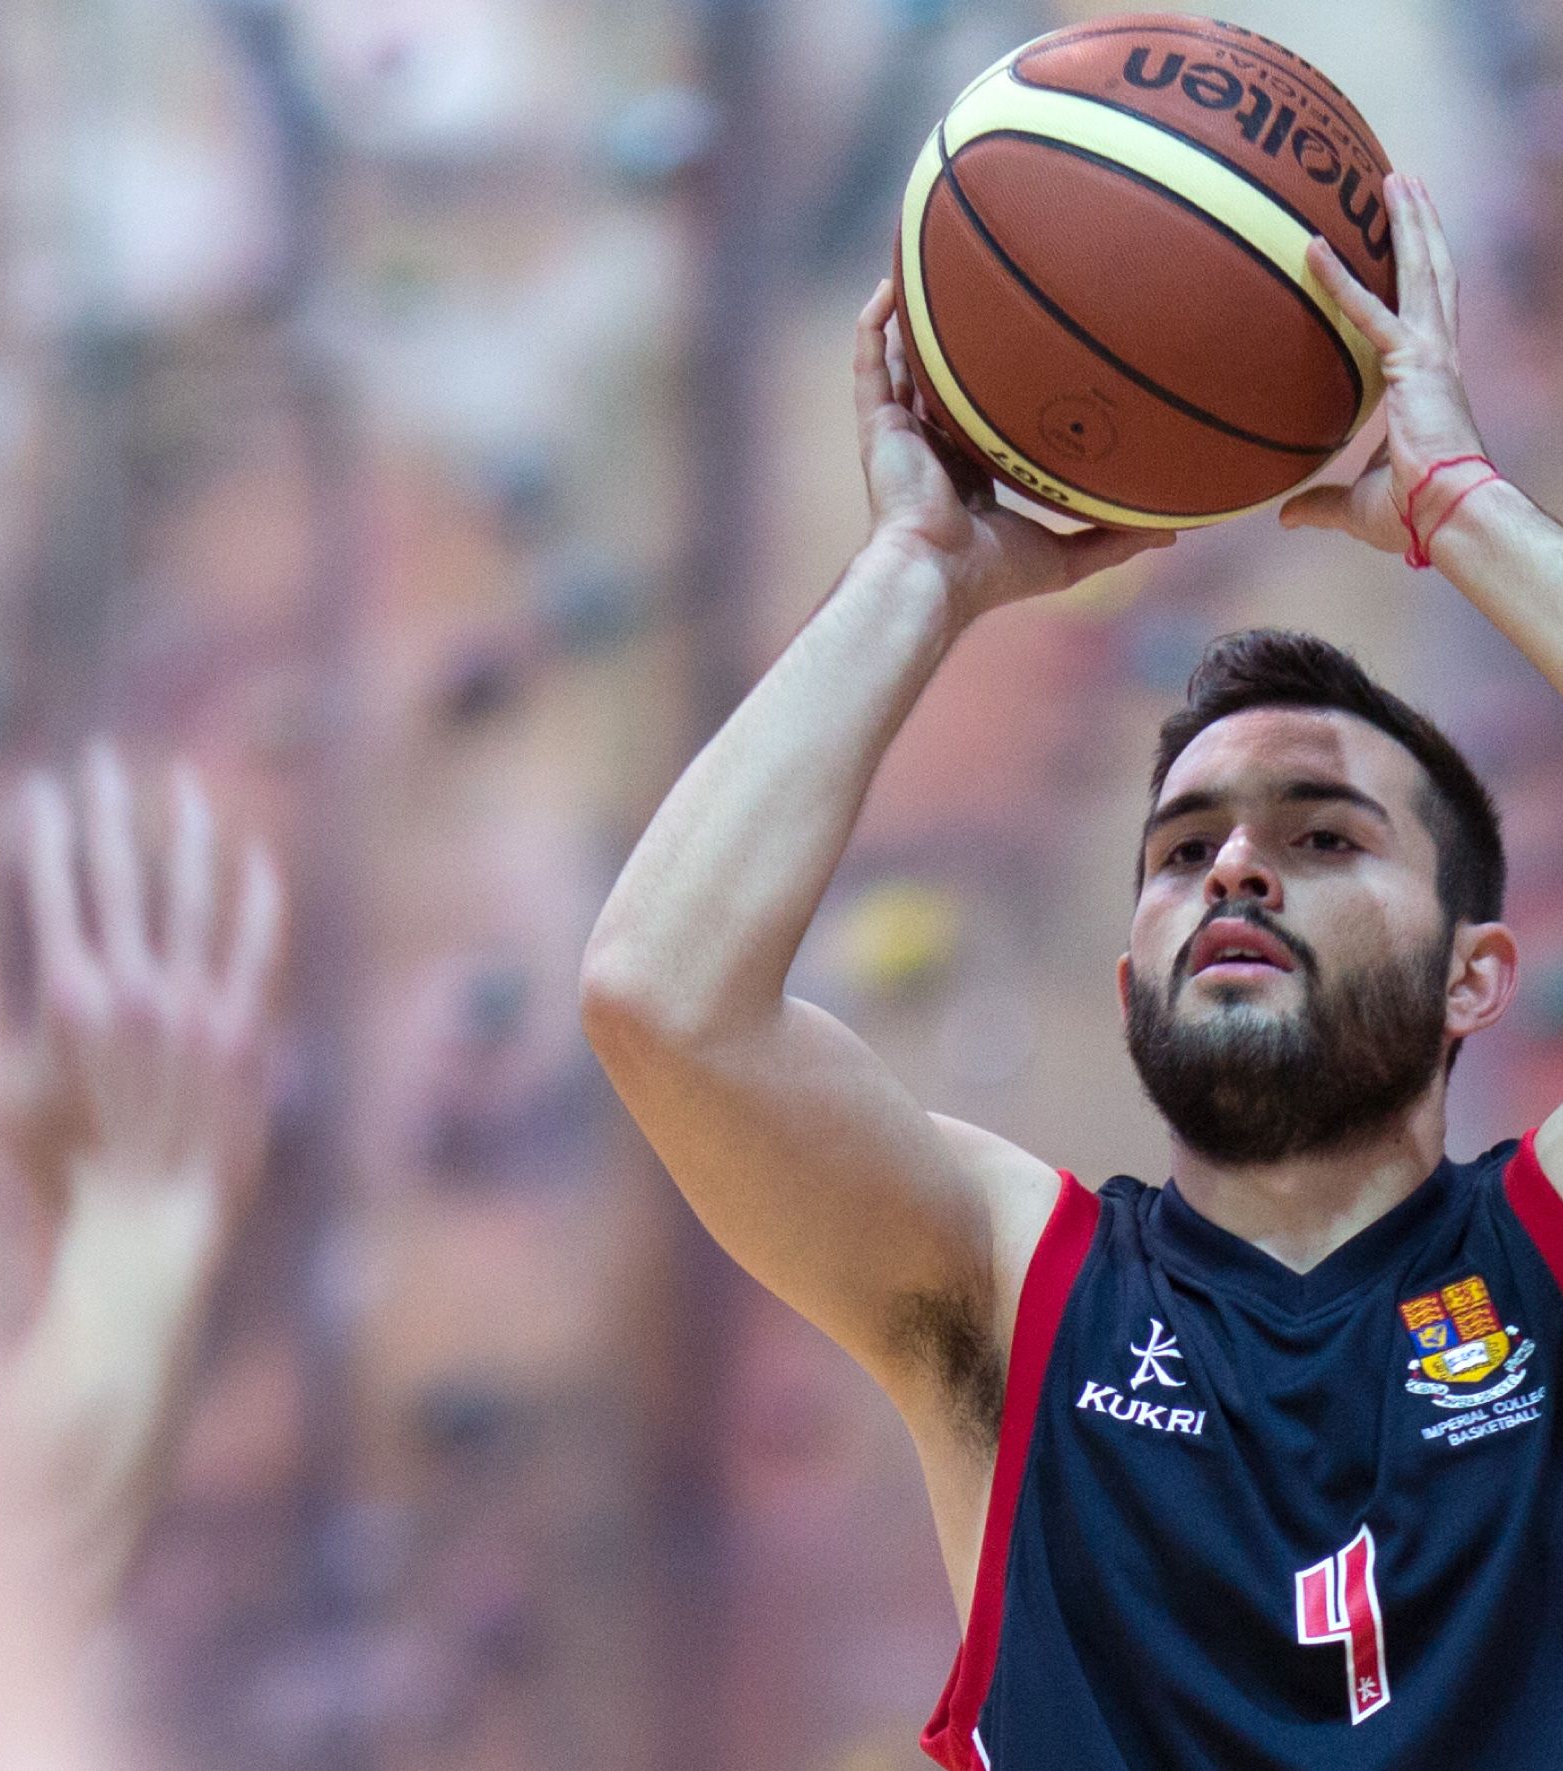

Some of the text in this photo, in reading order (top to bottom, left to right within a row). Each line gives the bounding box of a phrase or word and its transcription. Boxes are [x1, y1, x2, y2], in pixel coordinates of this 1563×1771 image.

[1123, 48, 1391, 261] molten
[1077, 1382, 1206, 1435] KUKRI
[1421, 1409, 1490, 1440] IMPERIAL
[1447, 1408, 1542, 1446] BASKETBALL
[1295, 1523, 1390, 1726] 4
